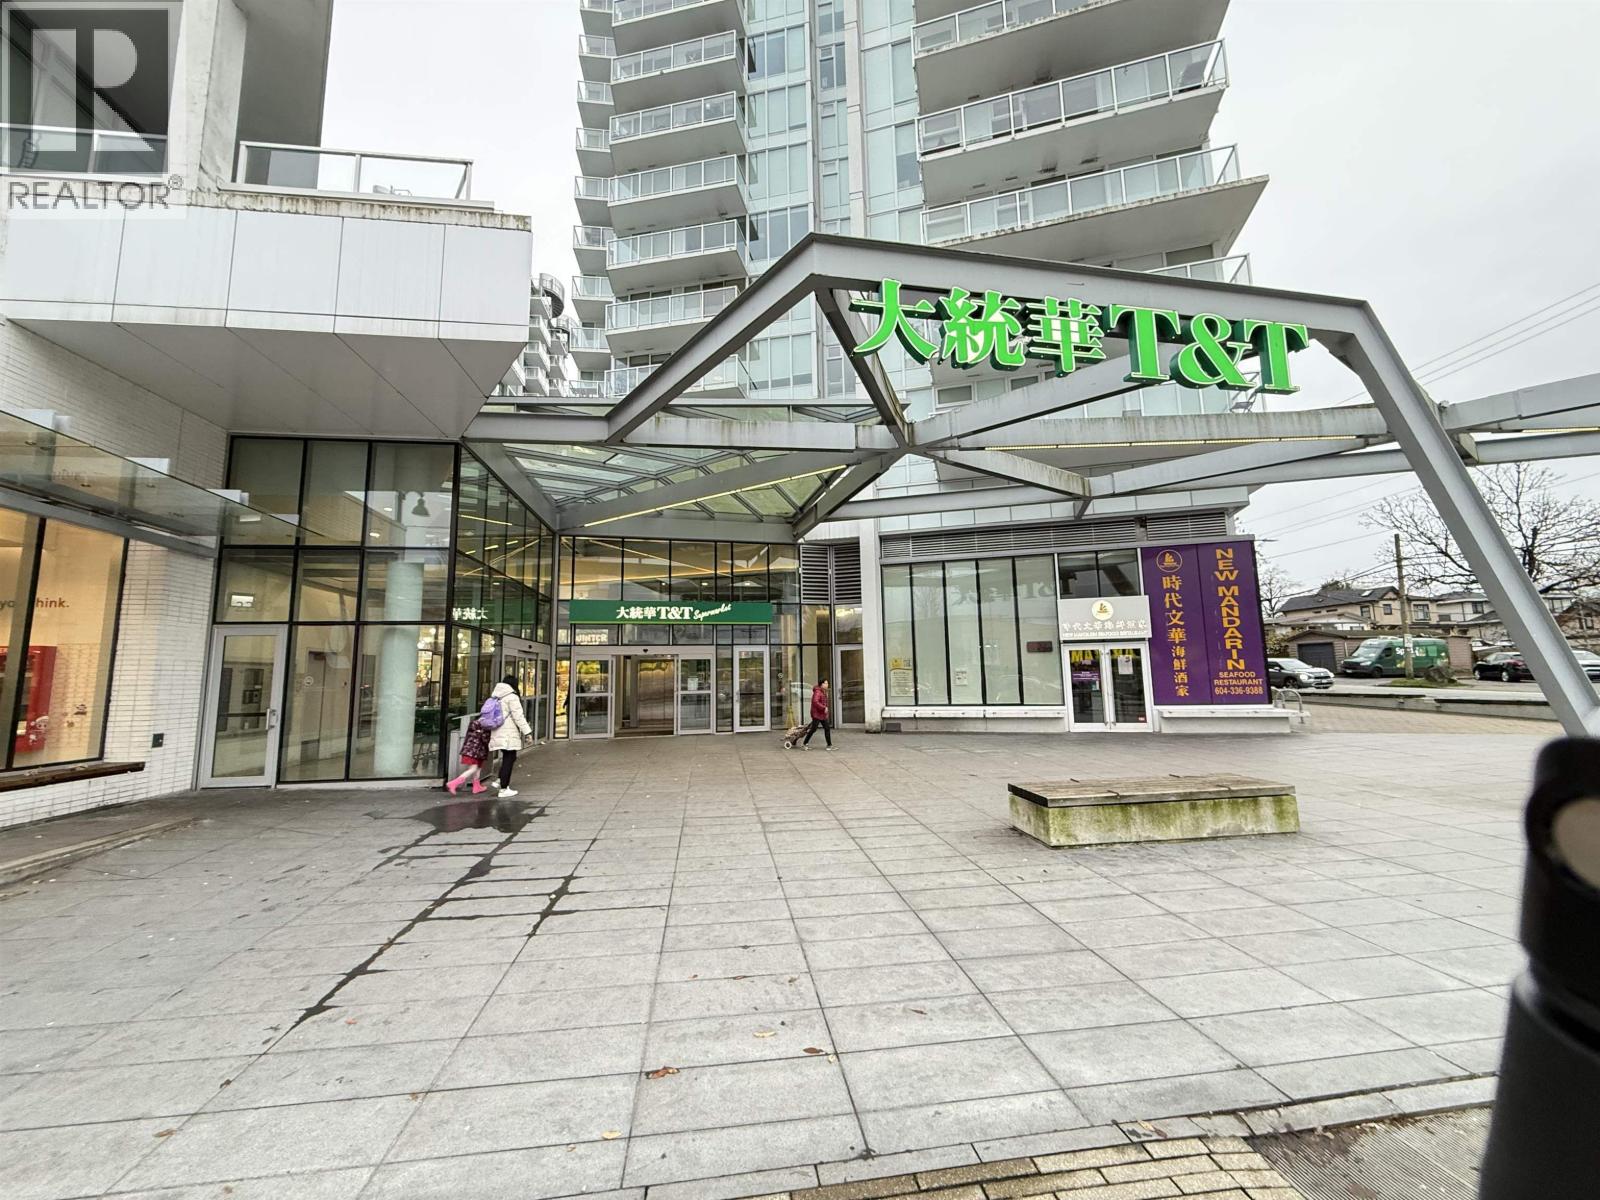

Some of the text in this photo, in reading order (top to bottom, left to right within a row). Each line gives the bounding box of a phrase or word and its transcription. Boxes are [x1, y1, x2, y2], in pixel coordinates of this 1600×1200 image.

[849, 278, 1310, 395] 大統華 T&T
[1214, 548, 1239, 582] NEW
[616, 606, 657, 620] 大統華
[656, 606, 694, 620] T&T
[1161, 575, 1190, 697] 時代文華海鮮酒家
[1217, 585, 1246, 671] MANDARIN
